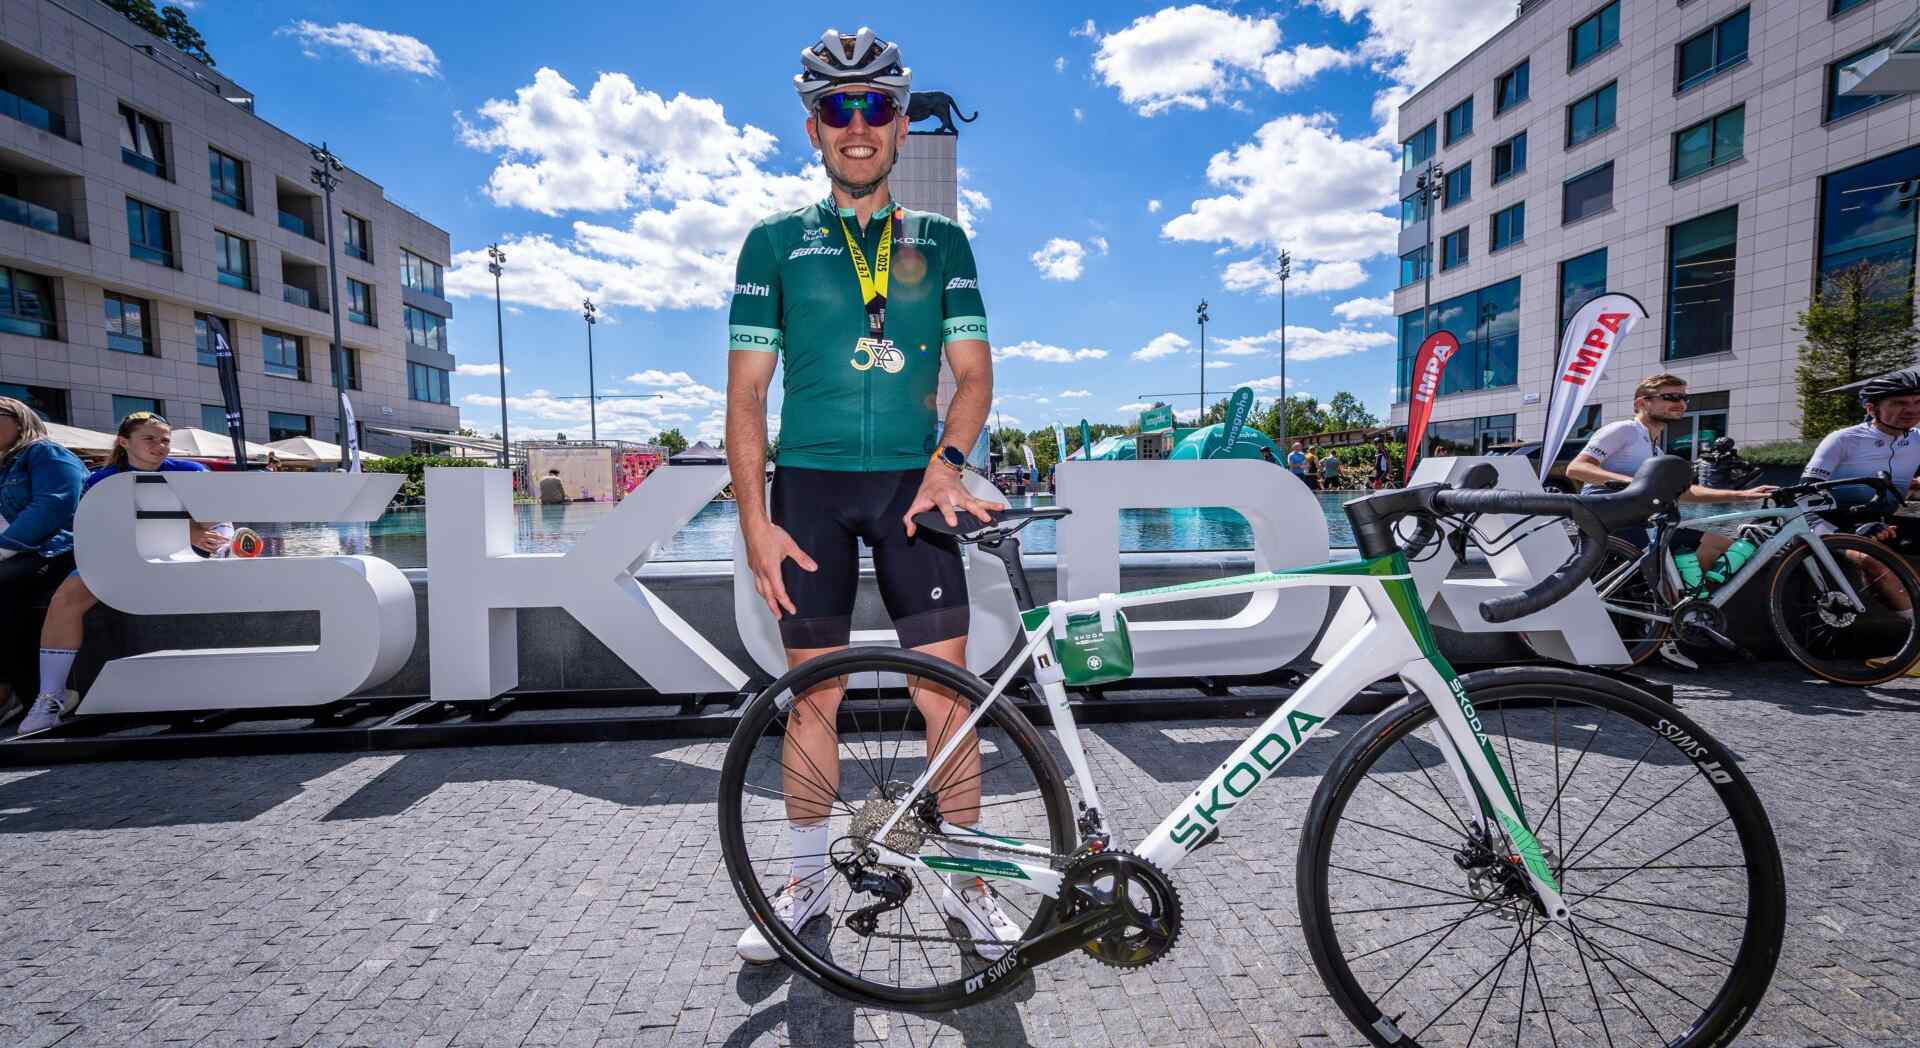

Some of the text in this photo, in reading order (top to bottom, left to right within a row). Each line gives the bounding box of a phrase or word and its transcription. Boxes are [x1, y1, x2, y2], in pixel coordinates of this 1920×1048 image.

[788, 246, 844, 260] Santini
[878, 253, 889, 273] 2025
[893, 237, 937, 246] KODA
[730, 333, 781, 346] KODA
[1562, 312, 1632, 386] IMPA
[1415, 345, 1451, 404] IMPA
[1222, 391, 1249, 454] hansgrohe
[1450, 678, 1488, 747] SKODA
[1169, 709, 1326, 851] SKODA
[1651, 718, 1735, 784] DT SWISS
[965, 972, 985, 995] DT
